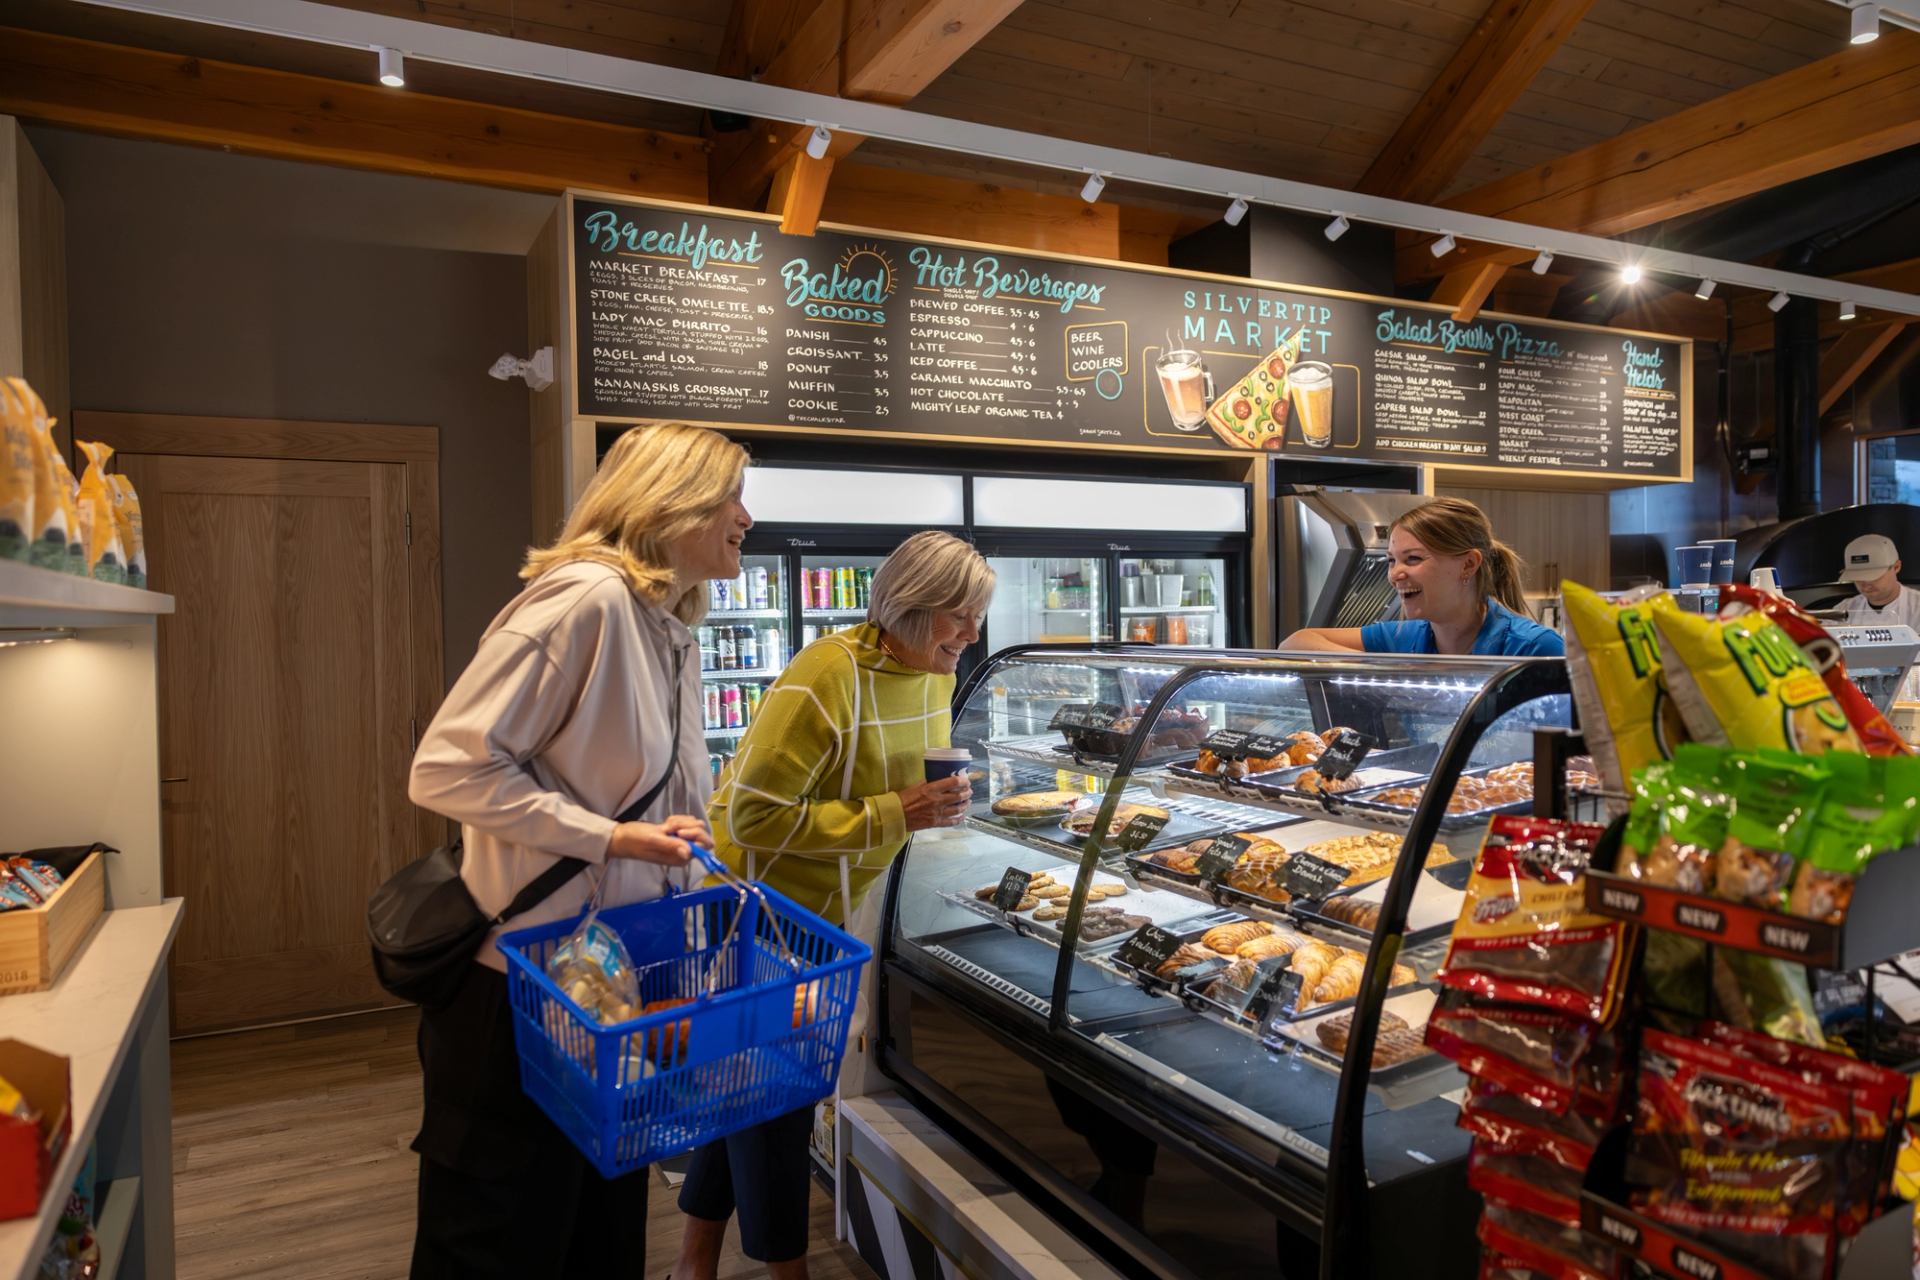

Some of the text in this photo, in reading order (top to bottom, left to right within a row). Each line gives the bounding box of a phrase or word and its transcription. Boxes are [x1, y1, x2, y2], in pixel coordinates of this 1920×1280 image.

[585, 211, 763, 269] Breakfast
[590, 261, 766, 286] MARKET BREAKFAST 17
[591, 278, 616, 286] TOAST
[781, 258, 889, 307] Baked
[909, 247, 1106, 313] Hot Beverages
[590, 289, 774, 315] STONE CREEK OMELETTE 18.5
[910, 299, 1040, 320] BREWED COFFEE 3.5 4.5
[1184, 290, 1331, 324] SILVERTIP
[592, 312, 768, 335] LADY MAC BURRITO 16
[804, 303, 886, 324] GOODS
[910, 312, 1035, 332] ESPRESSO 4 6
[786, 328, 887, 346] DANISH 4.5
[910, 328, 1035, 347] CAPPUCCINO 4.5 6
[1071, 331, 1103, 343] BEER
[1184, 315, 1332, 354] MARKET
[1376, 309, 1494, 353] Salad Bowls
[1072, 344, 1104, 356] WINE
[1496, 323, 1564, 360] Pizza
[593, 348, 768, 370] BAGEL and LOX 18
[787, 347, 888, 362] CROISSANT 3.5
[910, 342, 1036, 362] LATTE 4.5 6
[1374, 349, 1403, 360] CAESAR
[1622, 340, 1664, 369] Hand
[787, 363, 889, 379] DONUT 3.5
[910, 356, 1038, 376] ICED COFFEE 4.5 6
[1072, 357, 1123, 372] COOLERS
[1517, 369, 1541, 378] CHEESE
[910, 373, 1086, 397] CARAMEL MACCHIATO 5.5 6.5
[1375, 373, 1453, 388] QUINOA SALAD BOWL
[1623, 364, 1666, 390] Helds
[594, 377, 768, 398] KANANASKIS CROISSANT 17
[788, 380, 889, 398] MUFFIN 3.5
[1518, 383, 1536, 392] MAC
[788, 398, 889, 416] COOKIE 2.5
[910, 388, 933, 397] HOT
[938, 390, 1005, 402] CHOCOLATE
[1056, 400, 1062, 408] 4
[1499, 396, 1542, 406] NEAPOLITAN
[911, 402, 1064, 420] MIGHTY LEAF ORGANIC TEA 4
[1375, 403, 1407, 412] CAPRESE
[1410, 406, 1433, 415] SALAD
[1437, 409, 1460, 417] BOWL
[1499, 412, 1546, 422] WEST COAST
[1499, 440, 1530, 448] MARKET
[1529, 455, 1562, 465] FEATURE
[1292, 865, 1323, 883] Danish
[1603, 888, 1640, 912] NEW
[1679, 907, 1720, 931] NEW
[1764, 926, 1810, 951] NEW
[1602, 1216, 1638, 1245] NEW
[1677, 1250, 1717, 1280] NEW
